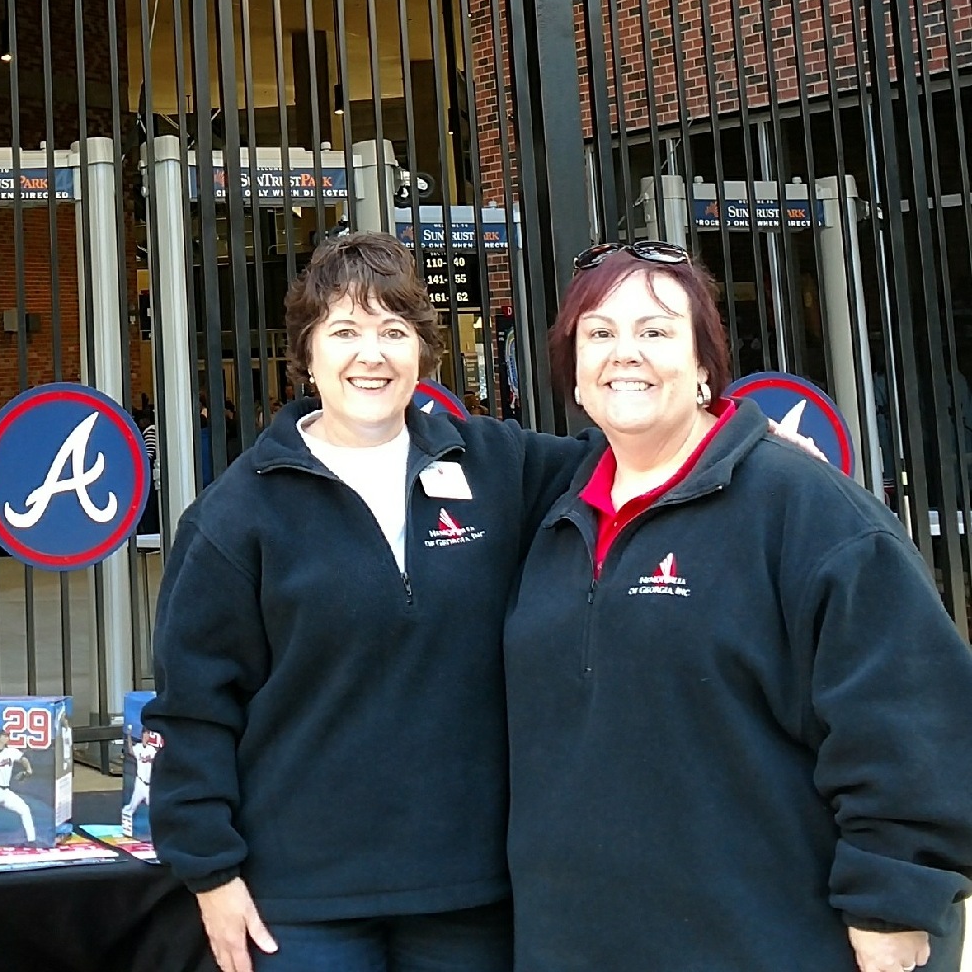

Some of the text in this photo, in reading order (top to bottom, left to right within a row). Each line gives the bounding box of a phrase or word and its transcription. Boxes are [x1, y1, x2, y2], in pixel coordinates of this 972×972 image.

[301, 174, 332, 187] PAK
[426, 258, 465, 268] 110-40
[4, 411, 118, 529] A
[3, 707, 51, 749] 29
